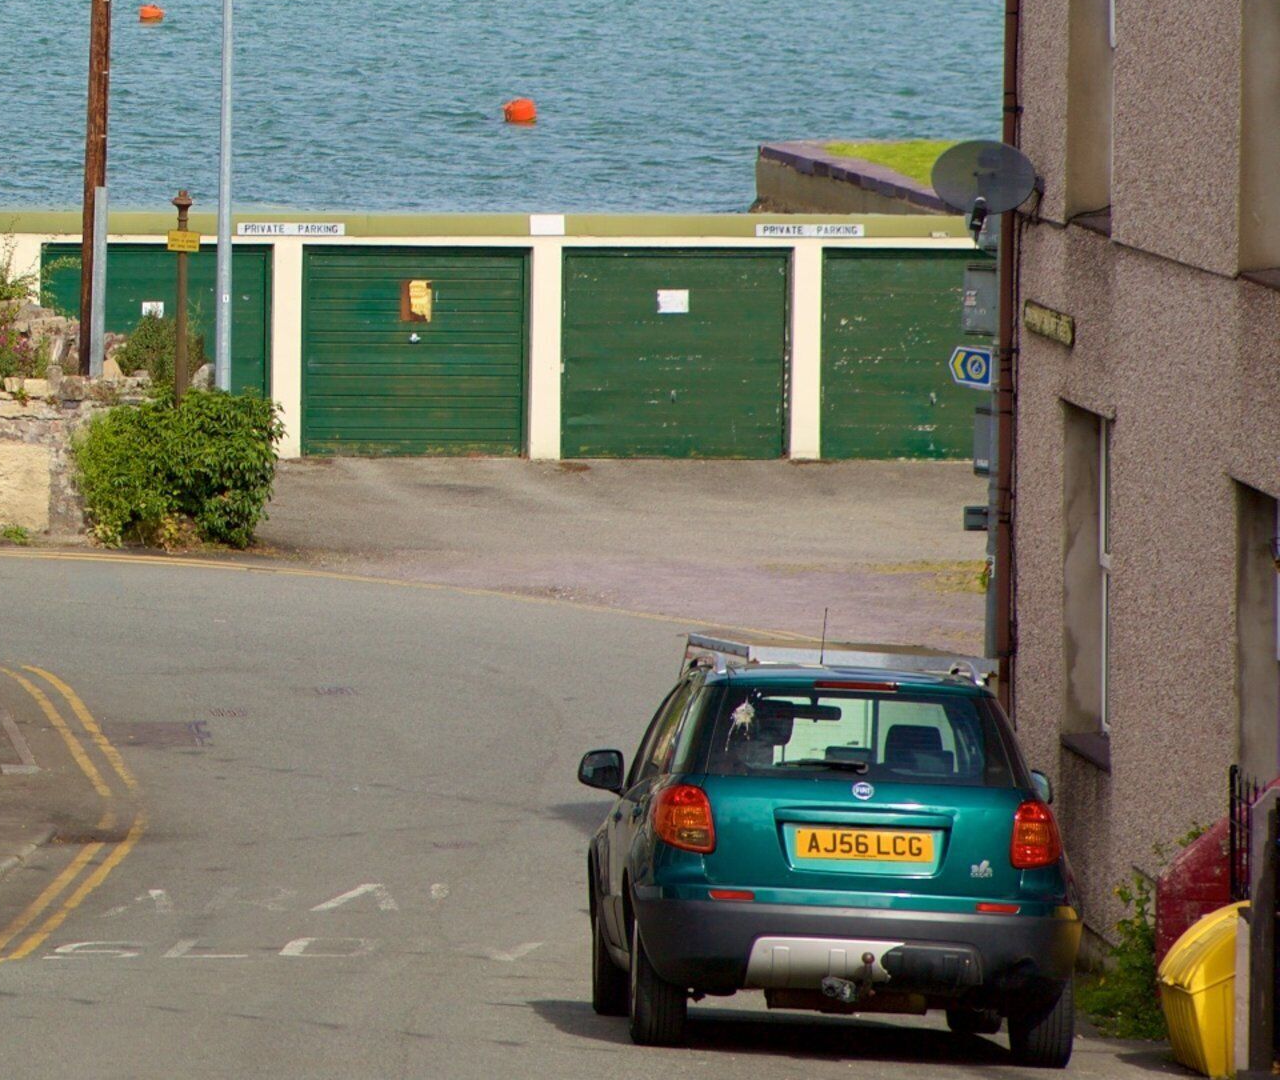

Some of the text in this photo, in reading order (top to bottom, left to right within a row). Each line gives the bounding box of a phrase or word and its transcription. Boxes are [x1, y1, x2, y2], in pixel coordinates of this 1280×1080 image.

[244, 224, 339, 234] PRIVATE PARKING
[763, 225, 858, 235] PRIVATE PARKING
[807, 832, 923, 857] AJ56 LCG
